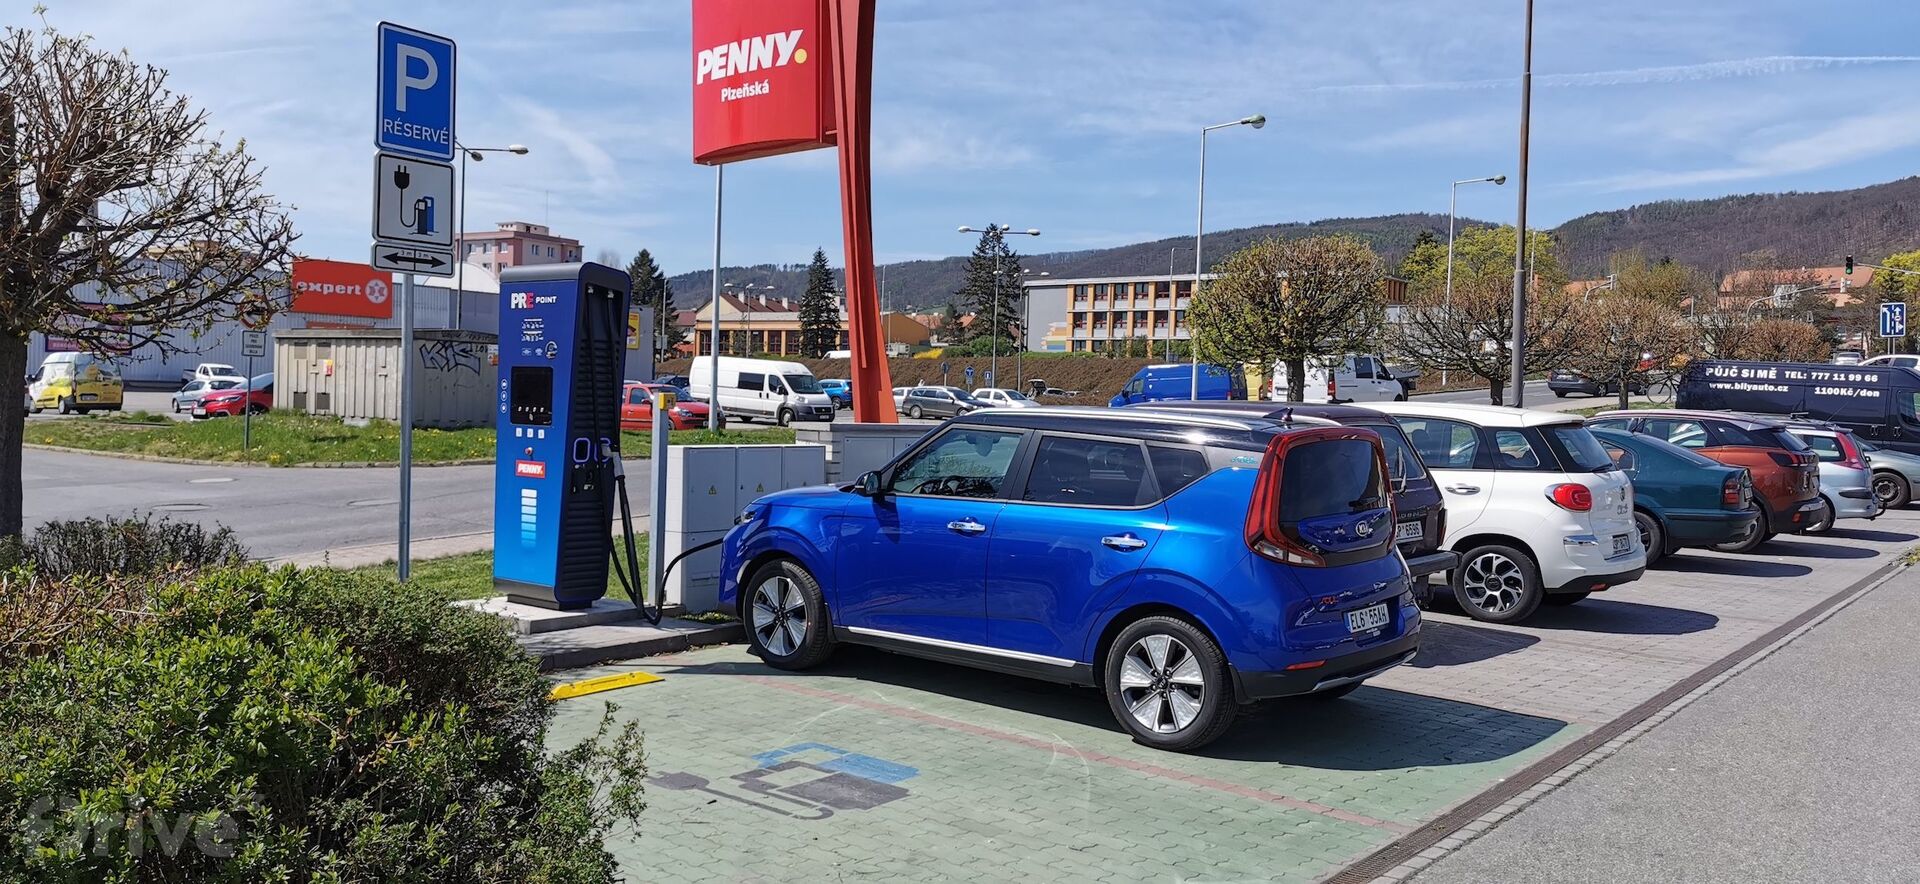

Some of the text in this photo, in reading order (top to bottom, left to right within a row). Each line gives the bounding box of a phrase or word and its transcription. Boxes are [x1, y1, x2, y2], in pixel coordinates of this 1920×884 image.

[395, 42, 438, 113] P
[720, 79, 770, 102] Plzeňská
[383, 117, 449, 145] RÉSERVÉ
[296, 281, 361, 295] expert
[510, 292, 557, 309] PRE POINT
[1705, 365, 1738, 377] PŮJČ
[1757, 367, 1778, 379] MĚ
[1784, 370, 1807, 379] TEL:
[1811, 372, 1830, 380] 777
[1832, 373, 1845, 381] 11
[1848, 374, 1862, 382] 99
[1864, 374, 1878, 382] 66
[1814, 386, 1880, 397] 1100Kč/den
[1350, 605, 1387, 630] EL6 55AH
